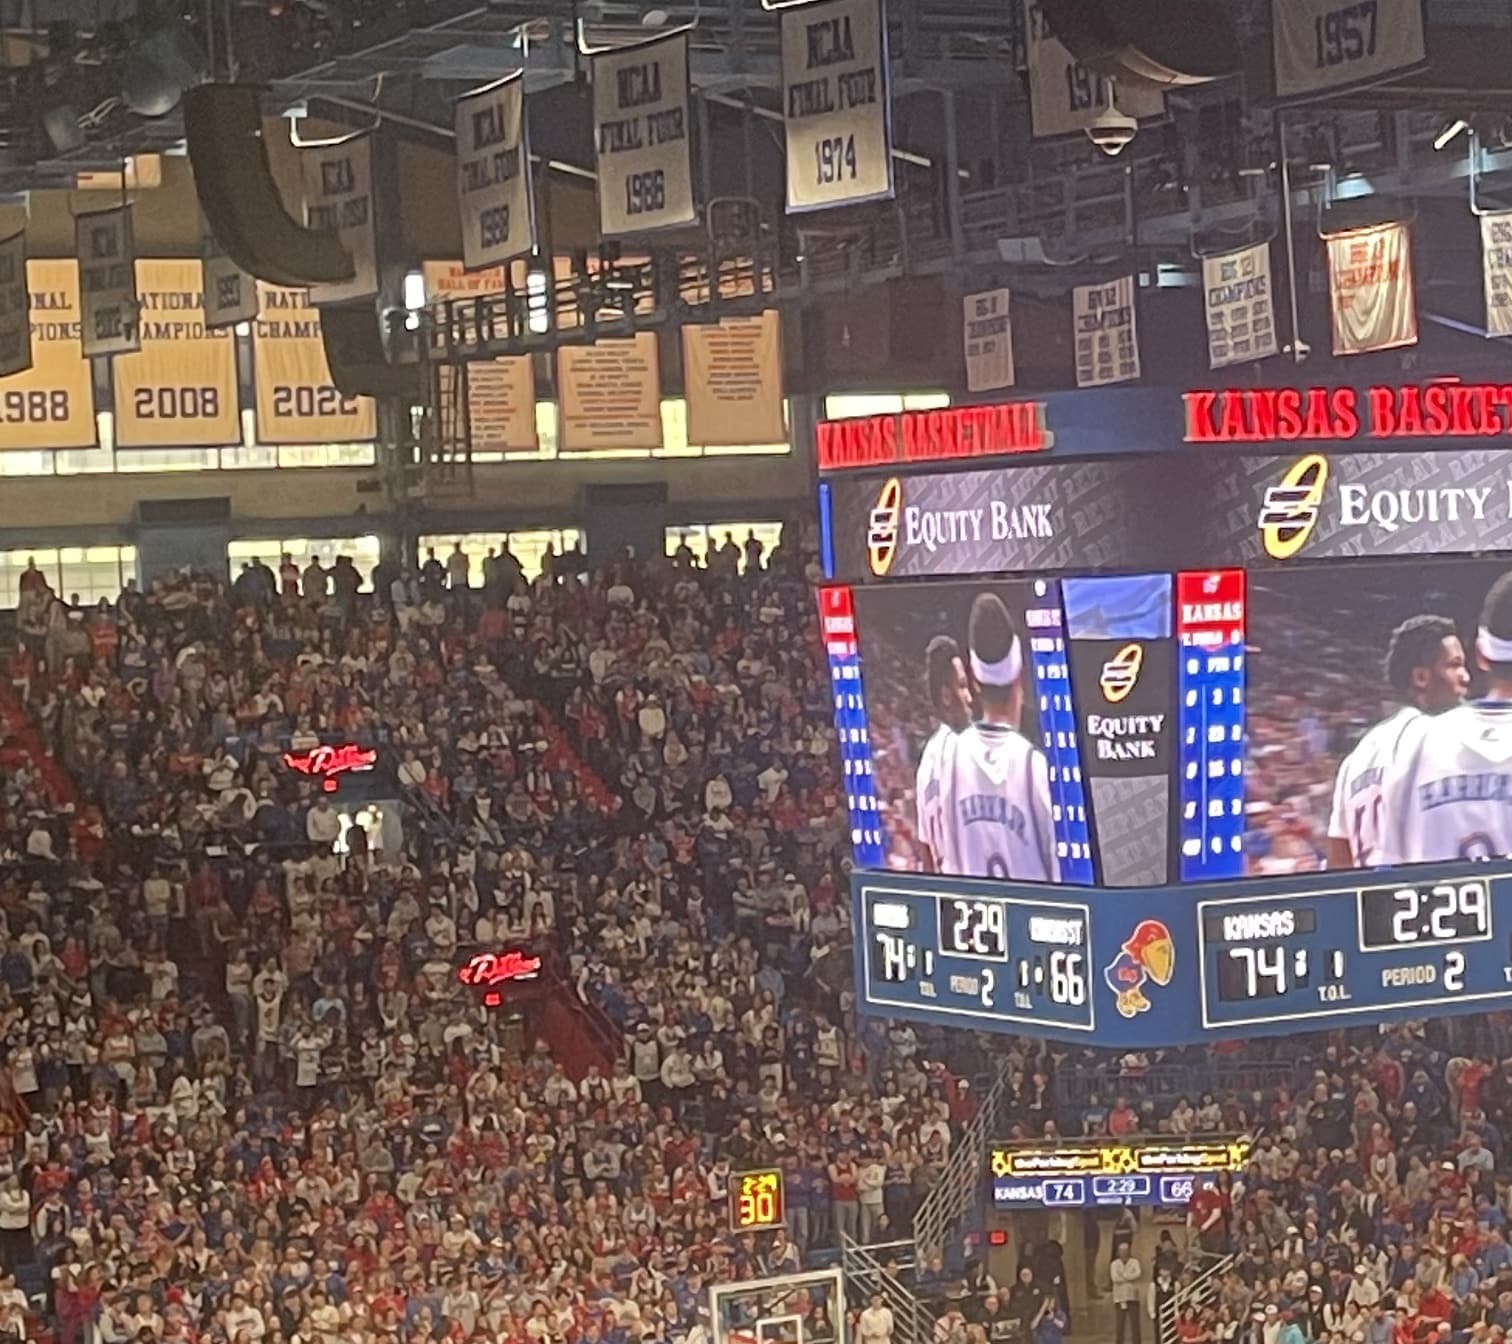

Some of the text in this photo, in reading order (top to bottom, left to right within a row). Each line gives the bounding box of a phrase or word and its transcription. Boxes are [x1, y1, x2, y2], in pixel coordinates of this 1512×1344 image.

[806, 16, 854, 69] NCAA
[1315, 0, 1378, 68] 1957
[617, 62, 660, 109] NCAA
[789, 68, 875, 118] FINAL FOUR
[600, 107, 685, 154] FINAL FOUR
[815, 134, 857, 185] 1974
[0, 390, 69, 422] 988
[134, 387, 219, 419] 2008
[1183, 387, 1358, 442] KANSAS
[817, 402, 1046, 469] KANSAS BASKETBALL
[905, 500, 1053, 552] EQUITY BANK
[1339, 481, 1491, 527] EQUITY
[1183, 603, 1241, 623] KANSAS
[1087, 715, 1164, 736] EQUITY
[1098, 740, 1156, 760] BANK
[953, 901, 1004, 953] 2:29
[1224, 910, 1294, 941] KANSAS
[1392, 883, 1486, 942] 2:29
[981, 968, 995, 1007] 2
[1050, 951, 1086, 1006] 66
[1229, 946, 1286, 996] 74
[1382, 965, 1436, 987] PERIOD
[1443, 952, 1465, 990] 2
[743, 1173, 777, 1195] 2:29
[995, 1180, 1192, 1200] KANSAS 74 2:29 66
[740, 1193, 772, 1225] 30
